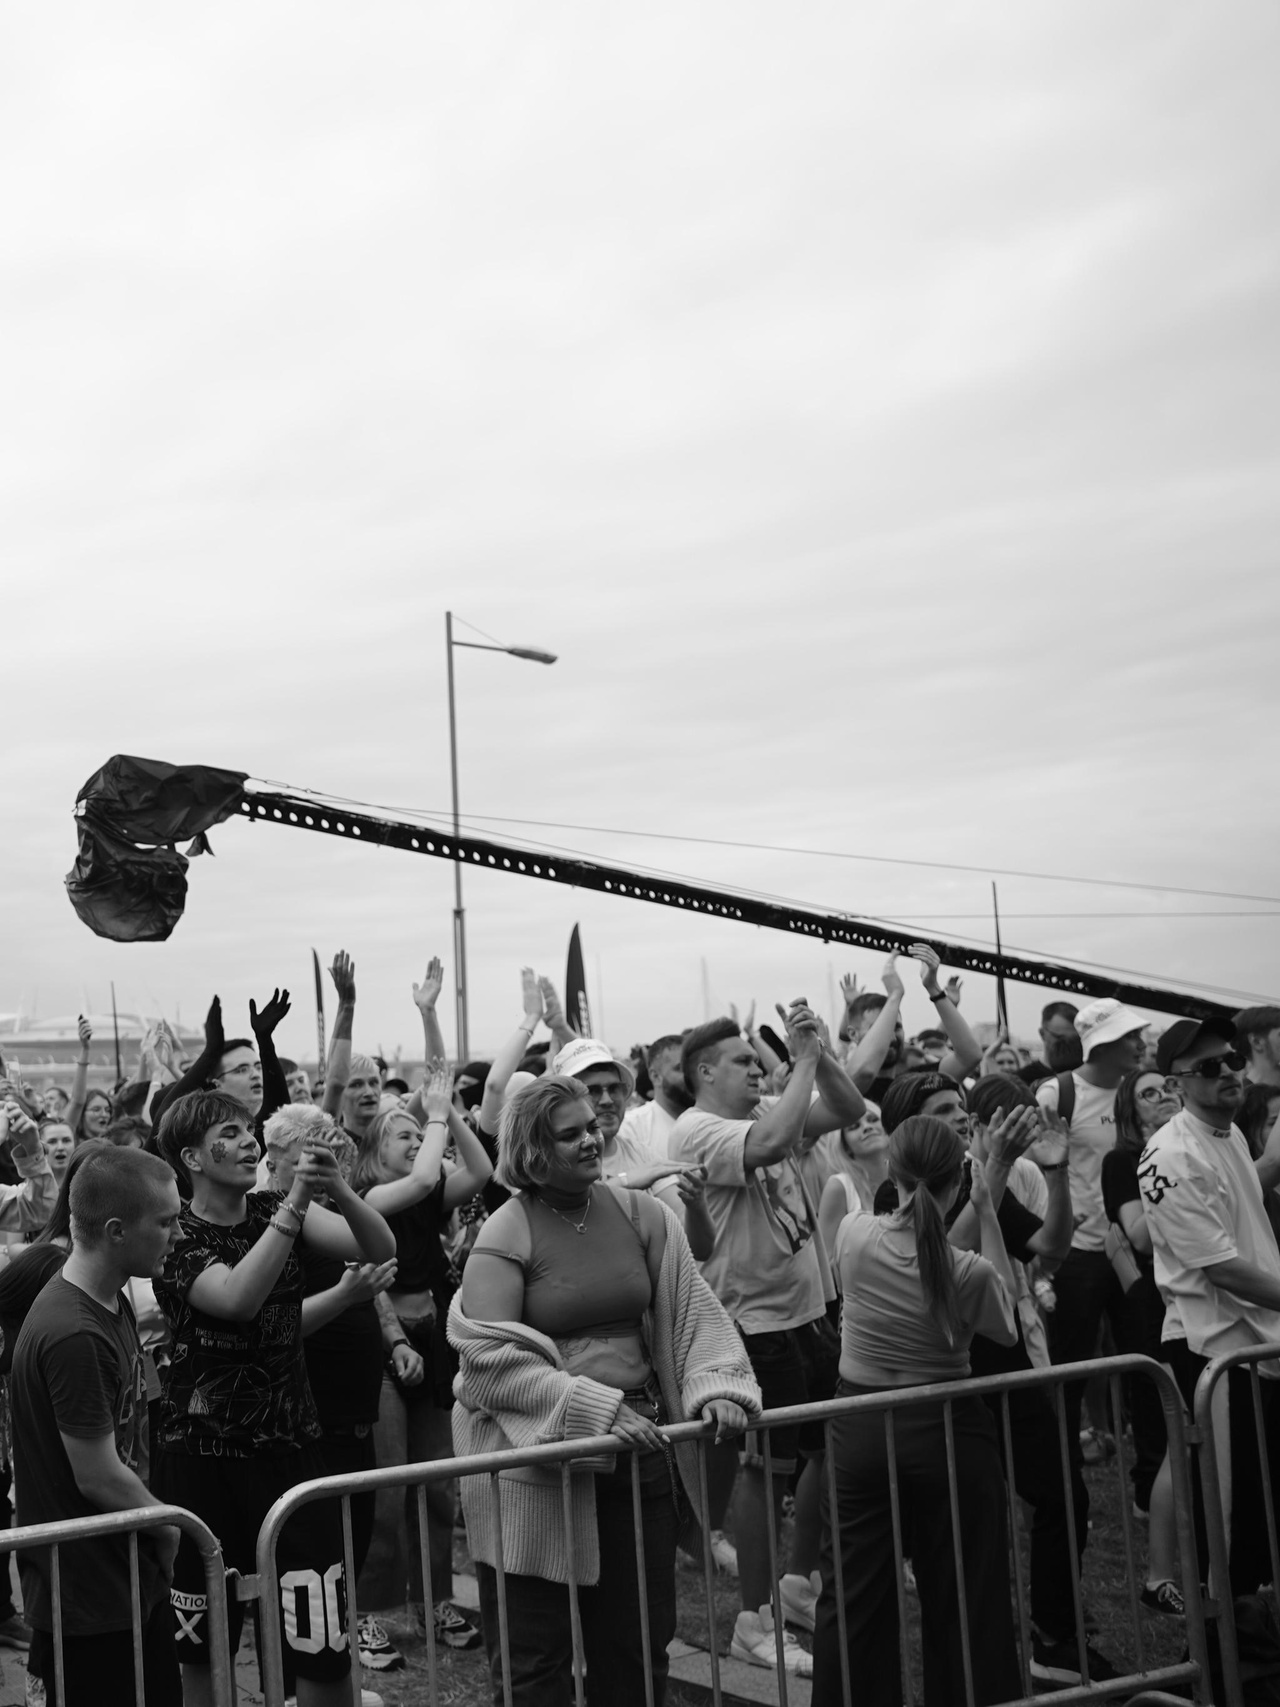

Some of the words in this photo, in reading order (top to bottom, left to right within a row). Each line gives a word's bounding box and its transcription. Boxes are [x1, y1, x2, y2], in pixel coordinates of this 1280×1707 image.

[195, 1327, 212, 1339] TIMES
[200, 1337, 214, 1347] NEW
[216, 1340, 233, 1350] YORK
